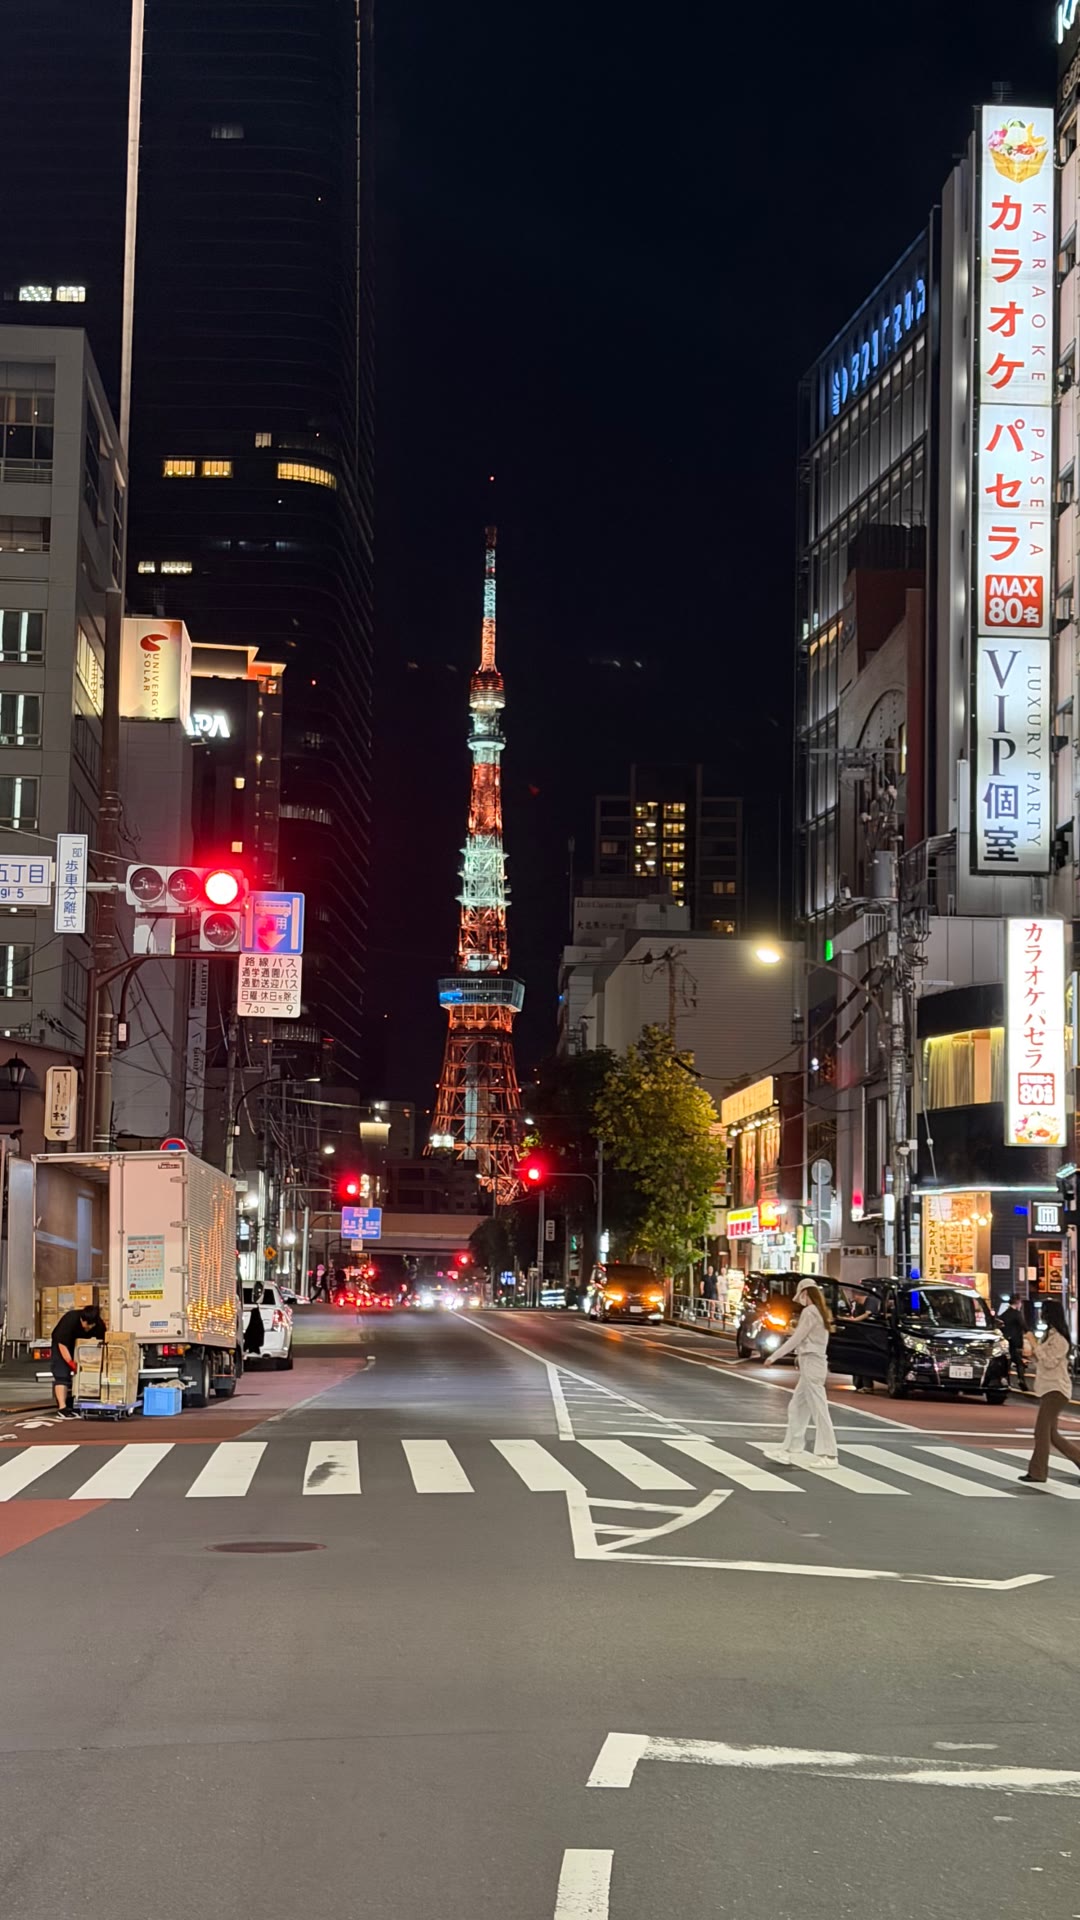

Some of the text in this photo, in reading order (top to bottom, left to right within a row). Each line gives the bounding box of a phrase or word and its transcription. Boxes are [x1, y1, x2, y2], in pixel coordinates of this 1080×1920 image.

[985, 194, 1025, 390] カラオケ
[1031, 202, 1047, 381] KARAOKE
[984, 418, 1027, 562] パセラ
[1029, 427, 1045, 557] PASELA
[988, 581, 1039, 598] MAX
[988, 597, 1040, 624] 80名
[143, 653, 151, 692] SOLAR
[982, 648, 1023, 863] VIP個室
[1026, 664, 1042, 847] LUXURY PARTY
[16, 888, 24, 899] 5
[245, 956, 296, 968] 路線バス
[1024, 922, 1046, 1007] カラオケ
[1024, 1009, 1048, 1069] パセラ
